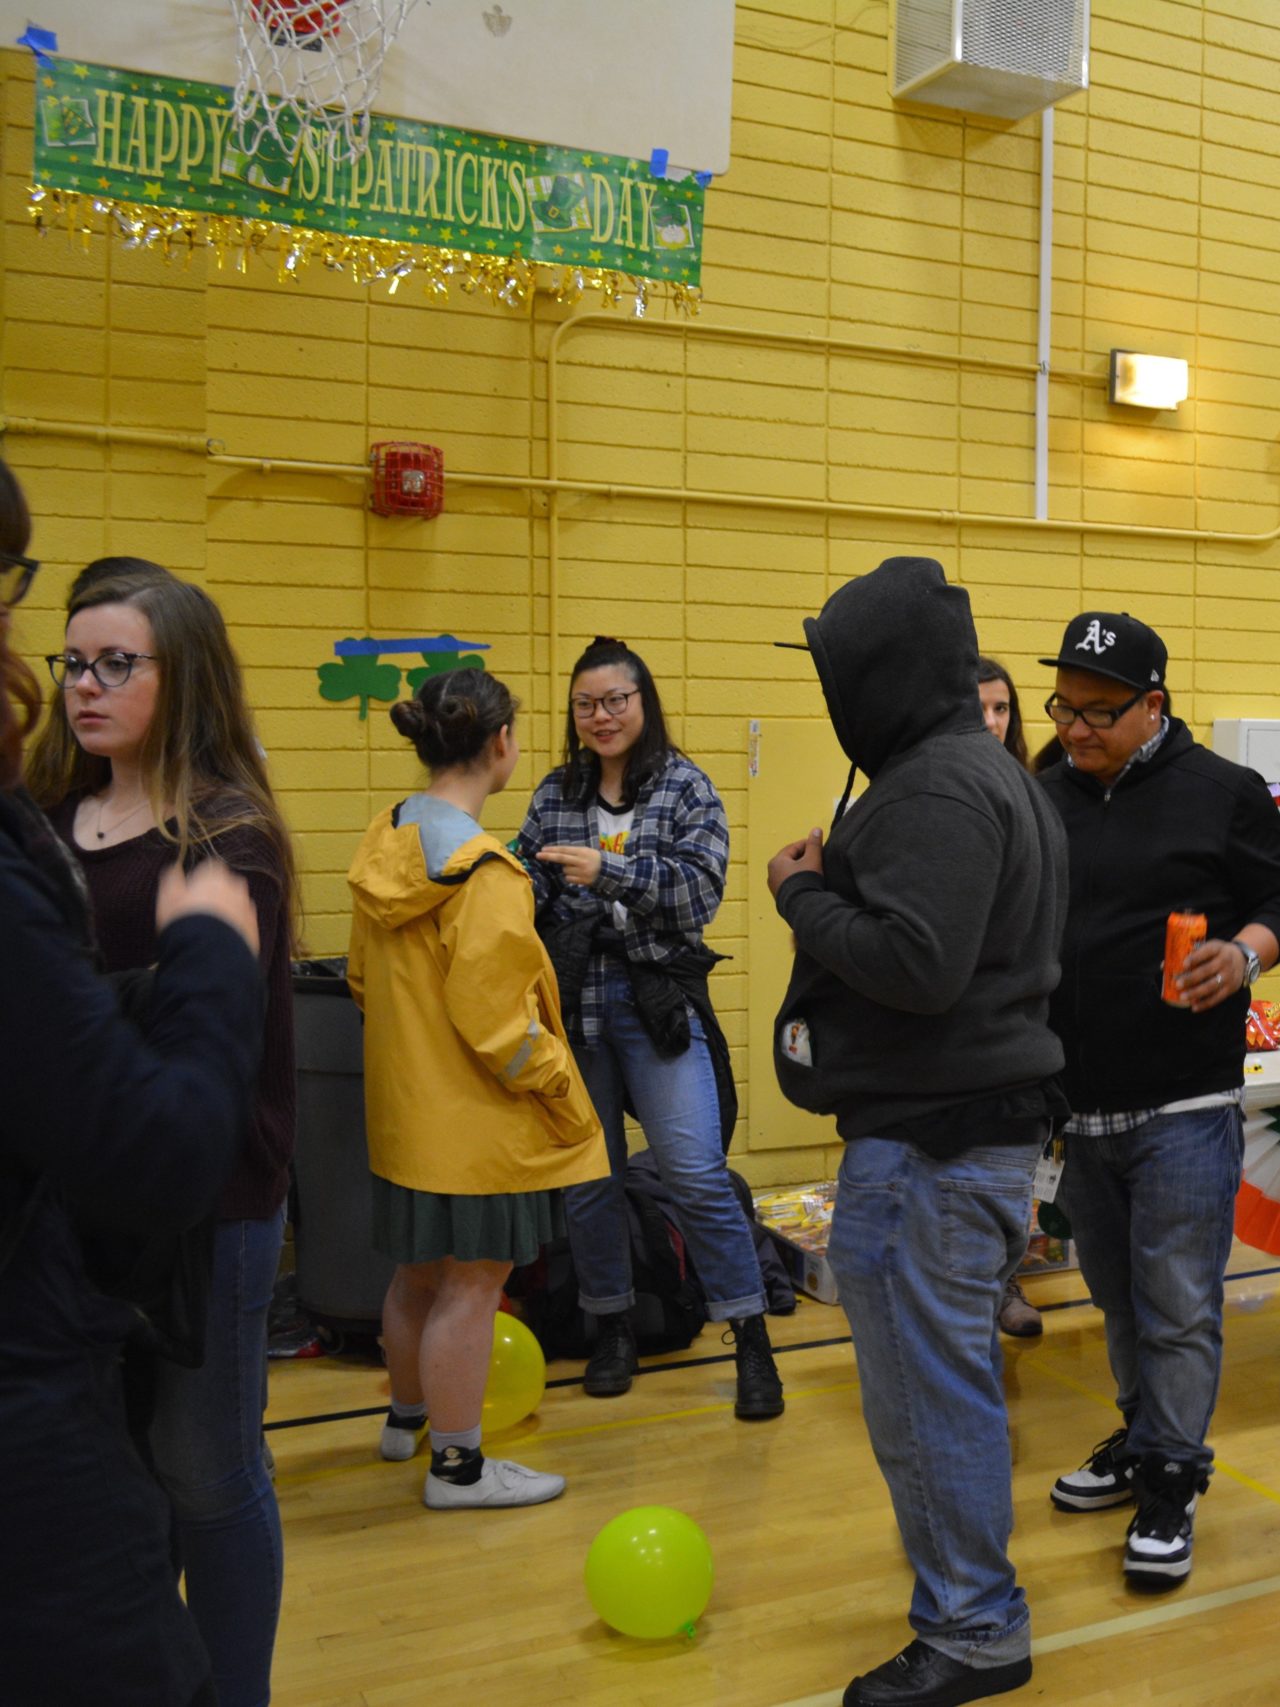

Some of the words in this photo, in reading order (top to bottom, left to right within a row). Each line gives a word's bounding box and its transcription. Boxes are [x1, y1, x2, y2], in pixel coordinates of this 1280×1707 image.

[92, 89, 233, 186] HAPPY
[348, 132, 526, 232] PATRICK'S
[590, 172, 657, 251] DAY
[1075, 619, 1117, 656] A's
